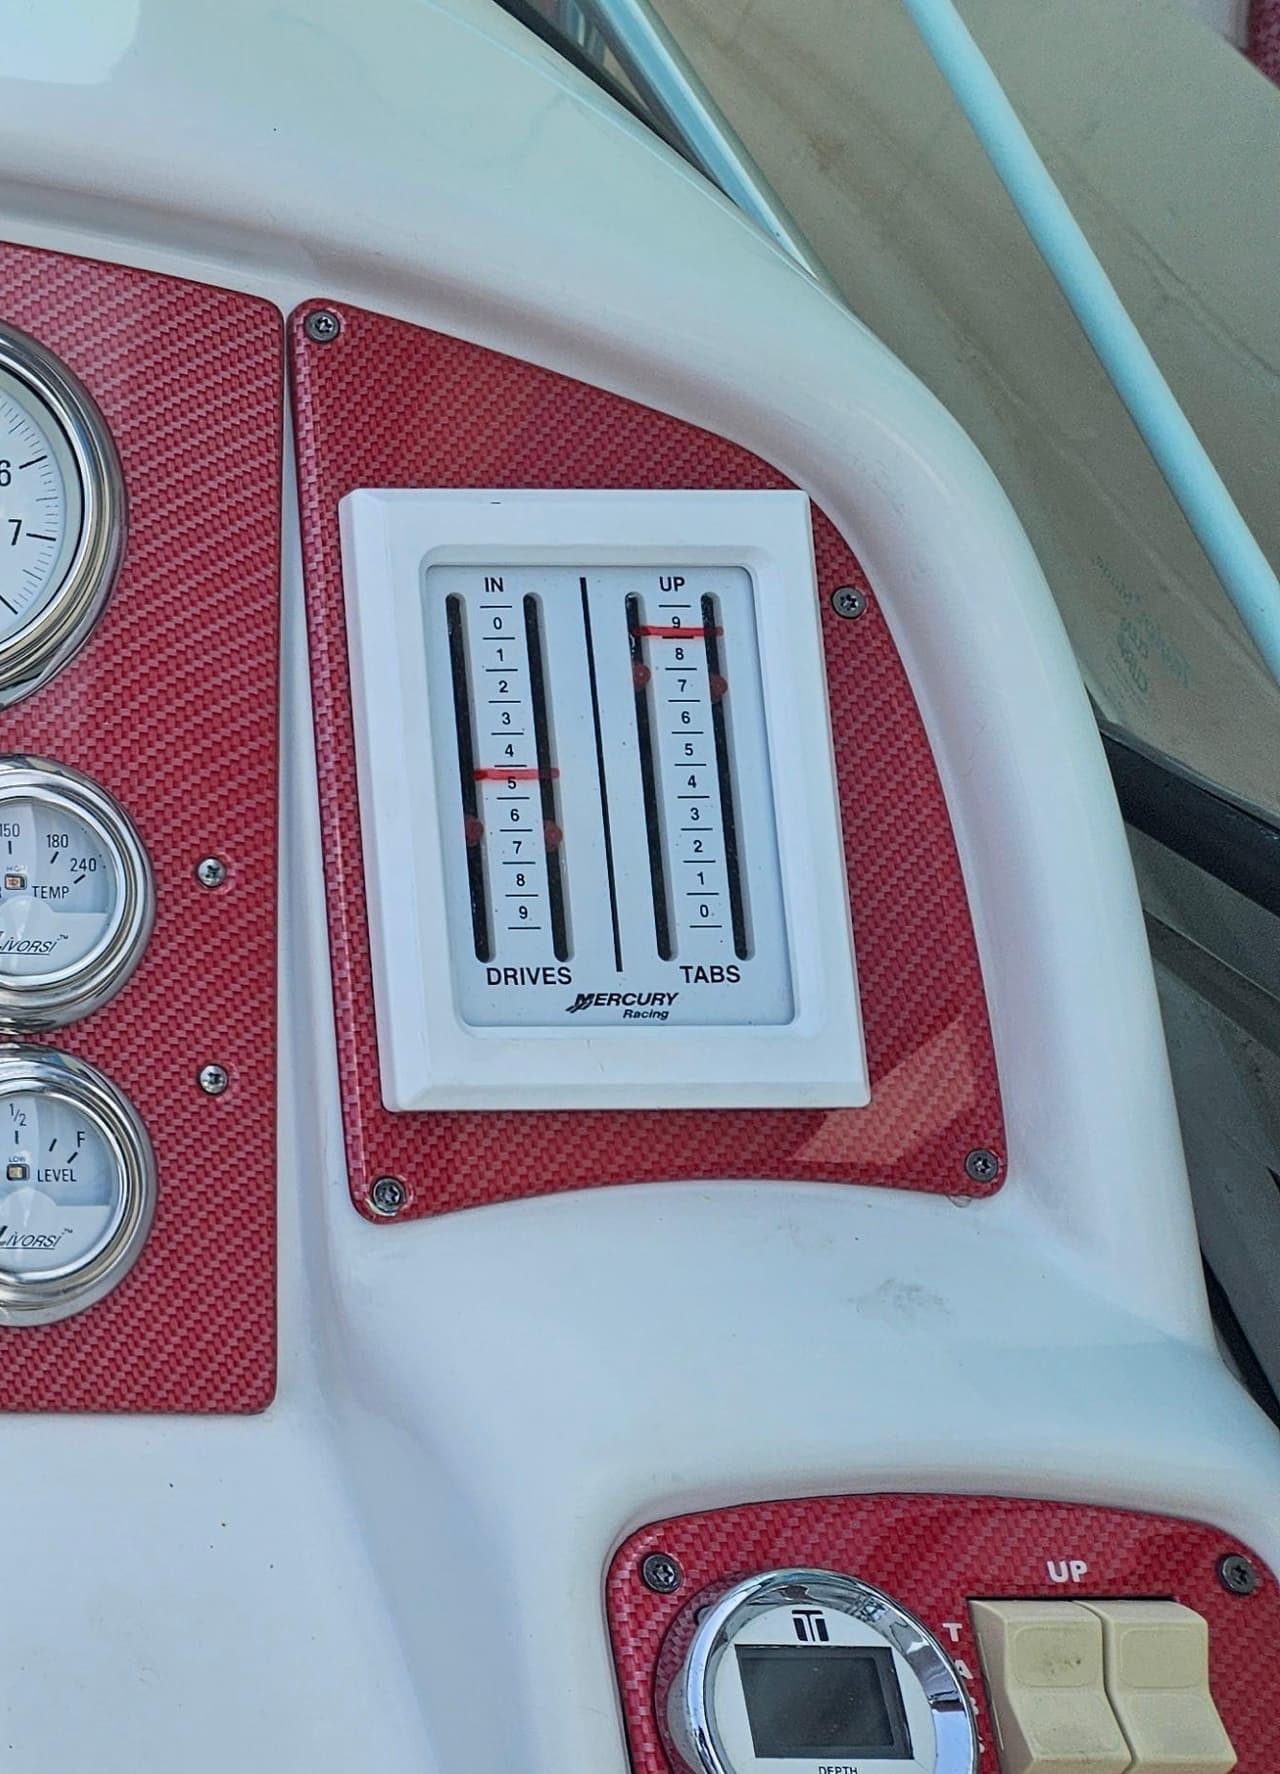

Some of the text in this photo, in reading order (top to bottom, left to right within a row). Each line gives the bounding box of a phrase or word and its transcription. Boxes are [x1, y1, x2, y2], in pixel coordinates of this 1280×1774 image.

[8, 519, 22, 546] 7
[484, 577, 504, 592] IN
[659, 576, 685, 592] UP
[493, 617, 502, 630] 0
[672, 616, 680, 629] 9
[498, 649, 505, 661] 1
[675, 648, 684, 660] 8
[498, 680, 508, 693] 2
[678, 680, 687, 693] 7
[502, 712, 511, 725] 3
[681, 711, 690, 724] 6
[504, 744, 514, 757] 4
[684, 743, 693, 756] 5
[507, 777, 517, 790] 5
[687, 775, 697, 788] 4
[510, 809, 519, 822] 6
[690, 808, 699, 820] 3
[47, 834, 68, 849] 180
[513, 841, 522, 854] 7
[693, 840, 703, 853] 2
[70, 858, 97, 872] 240
[516, 874, 525, 887] 8
[697, 872, 704, 885] 1
[32, 886, 69, 899] TEMP
[519, 906, 528, 919] 9
[700, 905, 708, 917] 0
[486, 967, 573, 986] DRIVES
[680, 965, 741, 983] TABS
[571, 993, 679, 1007] MERCURY
[623, 1009, 669, 1020] Racing
[77, 1131, 85, 1147] F
[37, 1169, 77, 1182] LEVEL
[1046, 1560, 1087, 1583] UP
